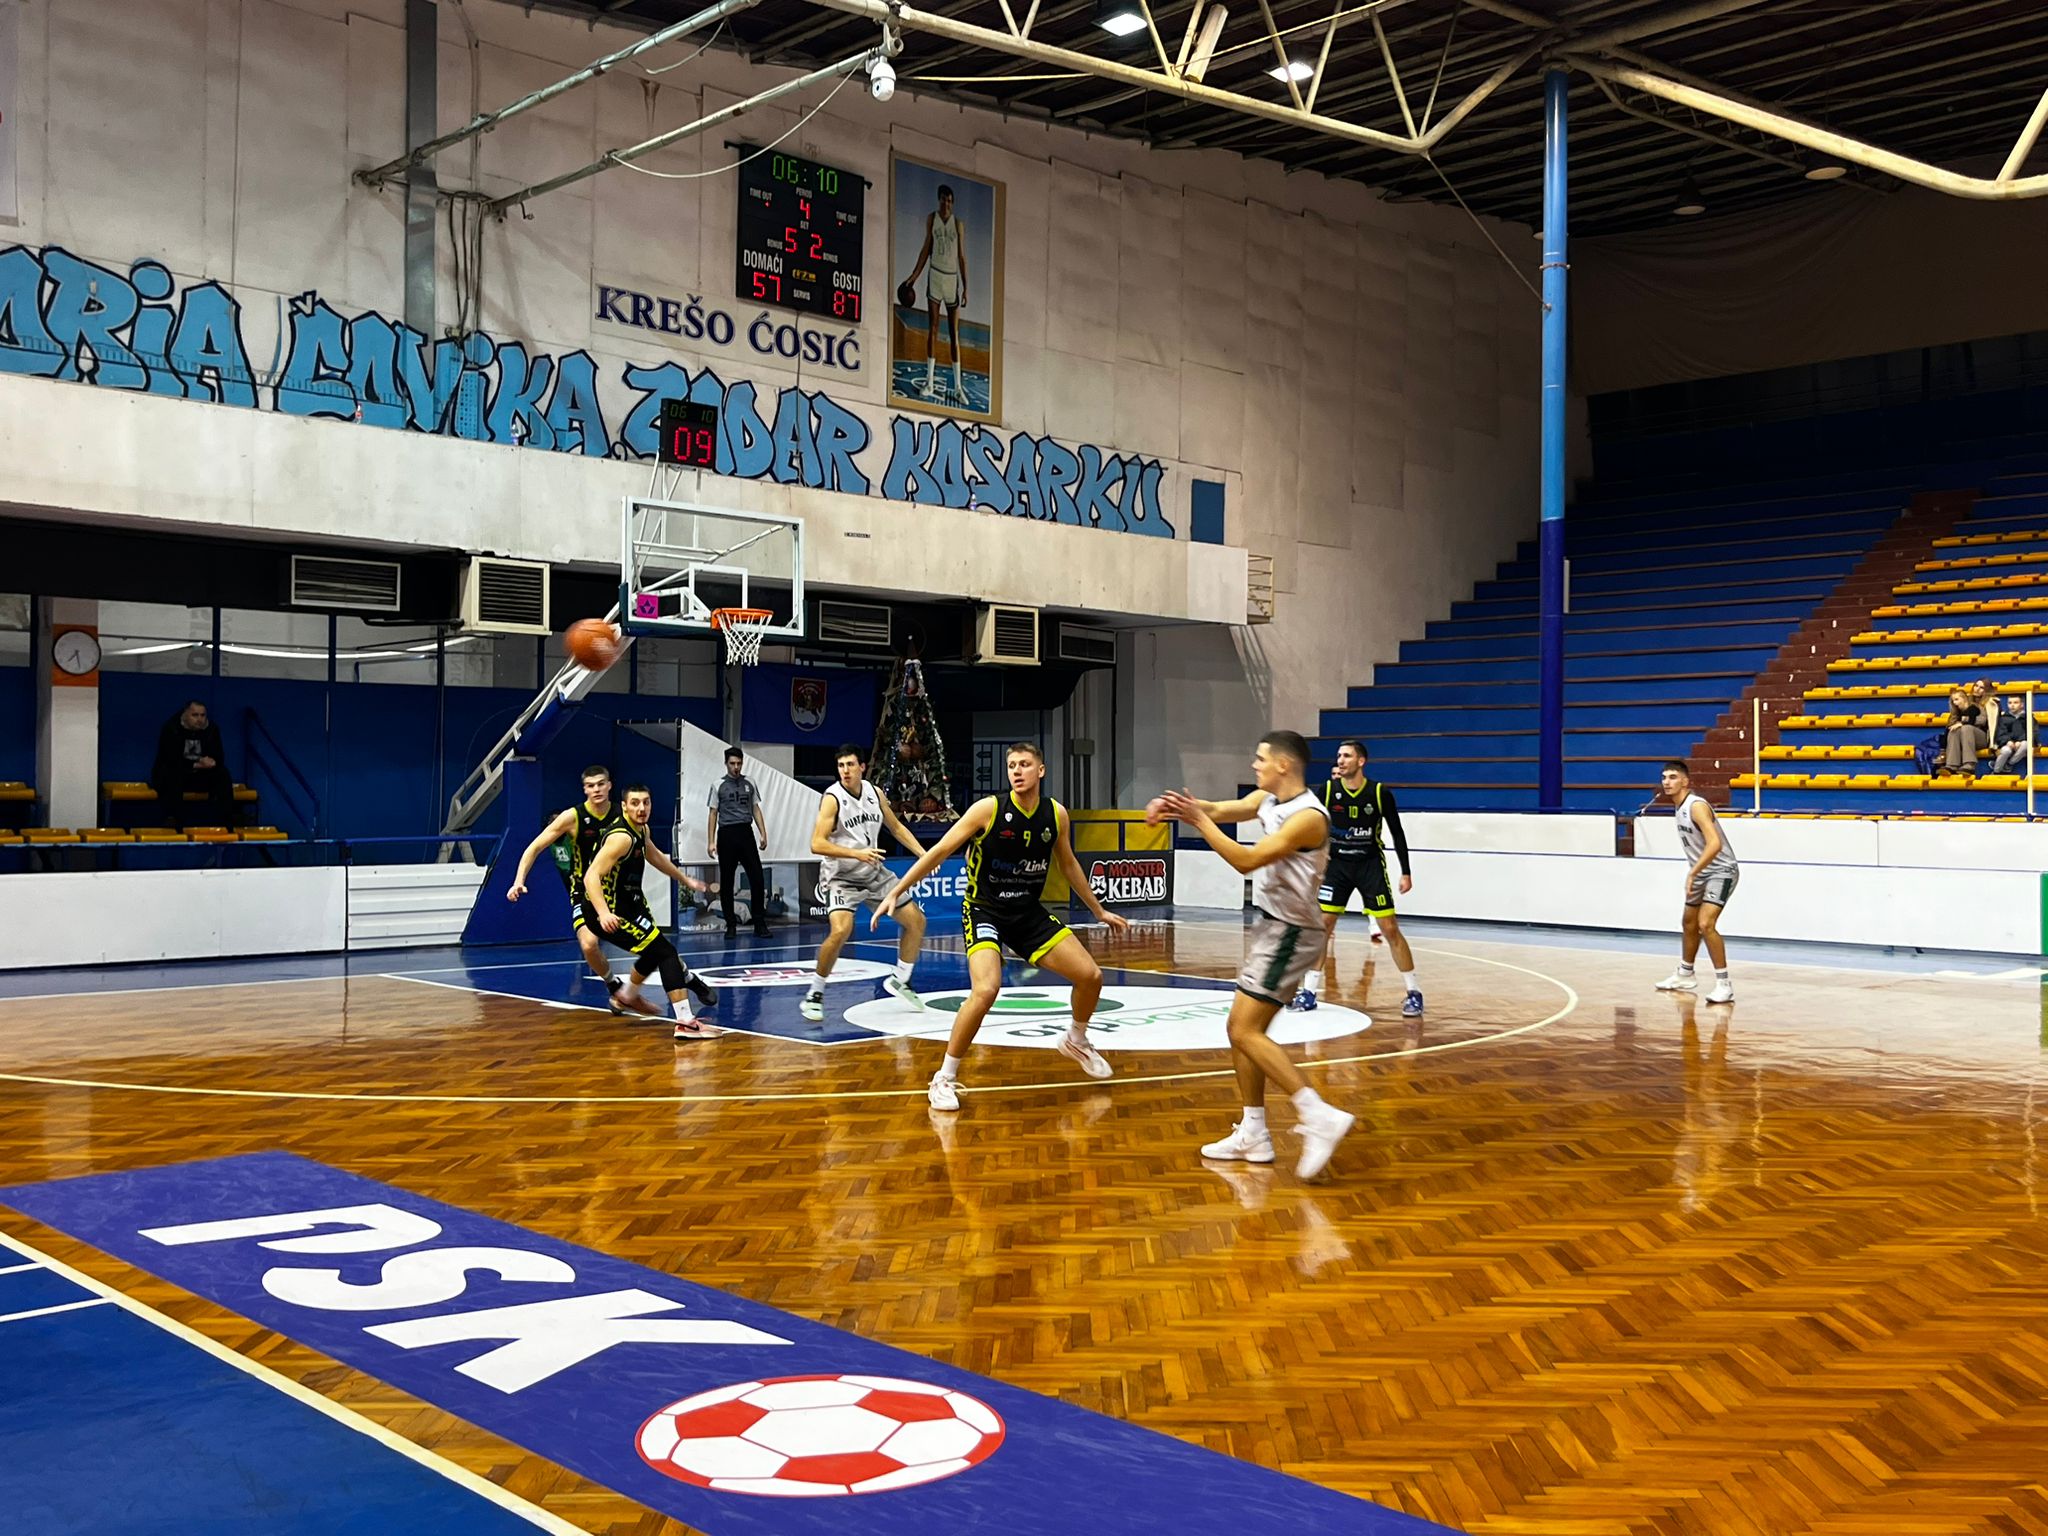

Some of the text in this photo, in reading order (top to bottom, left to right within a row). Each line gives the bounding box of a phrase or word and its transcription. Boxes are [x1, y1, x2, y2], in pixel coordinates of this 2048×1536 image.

[772, 155, 838, 195] 06:10
[799, 198, 811, 220] 4
[785, 227, 823, 260] 5 2
[743, 249, 783, 275] DOMAĆI
[753, 271, 782, 302] 57
[833, 271, 861, 293] GOSTI
[833, 290, 860, 320] 87
[595, 284, 862, 372] KREŠO ĆOSIĆ
[673, 426, 712, 464] 09
[881, 414, 1175, 539] KOŠARKU
[1348, 805, 1359, 819] 10
[1023, 830, 1032, 848] 9
[1108, 863, 1165, 877] MONSTER
[908, 877, 952, 898] RSTE
[1108, 876, 1165, 899] KEBAB
[834, 895, 845, 906] 16
[1376, 894, 1387, 906] 10
[138, 1203, 794, 1394] PSK
